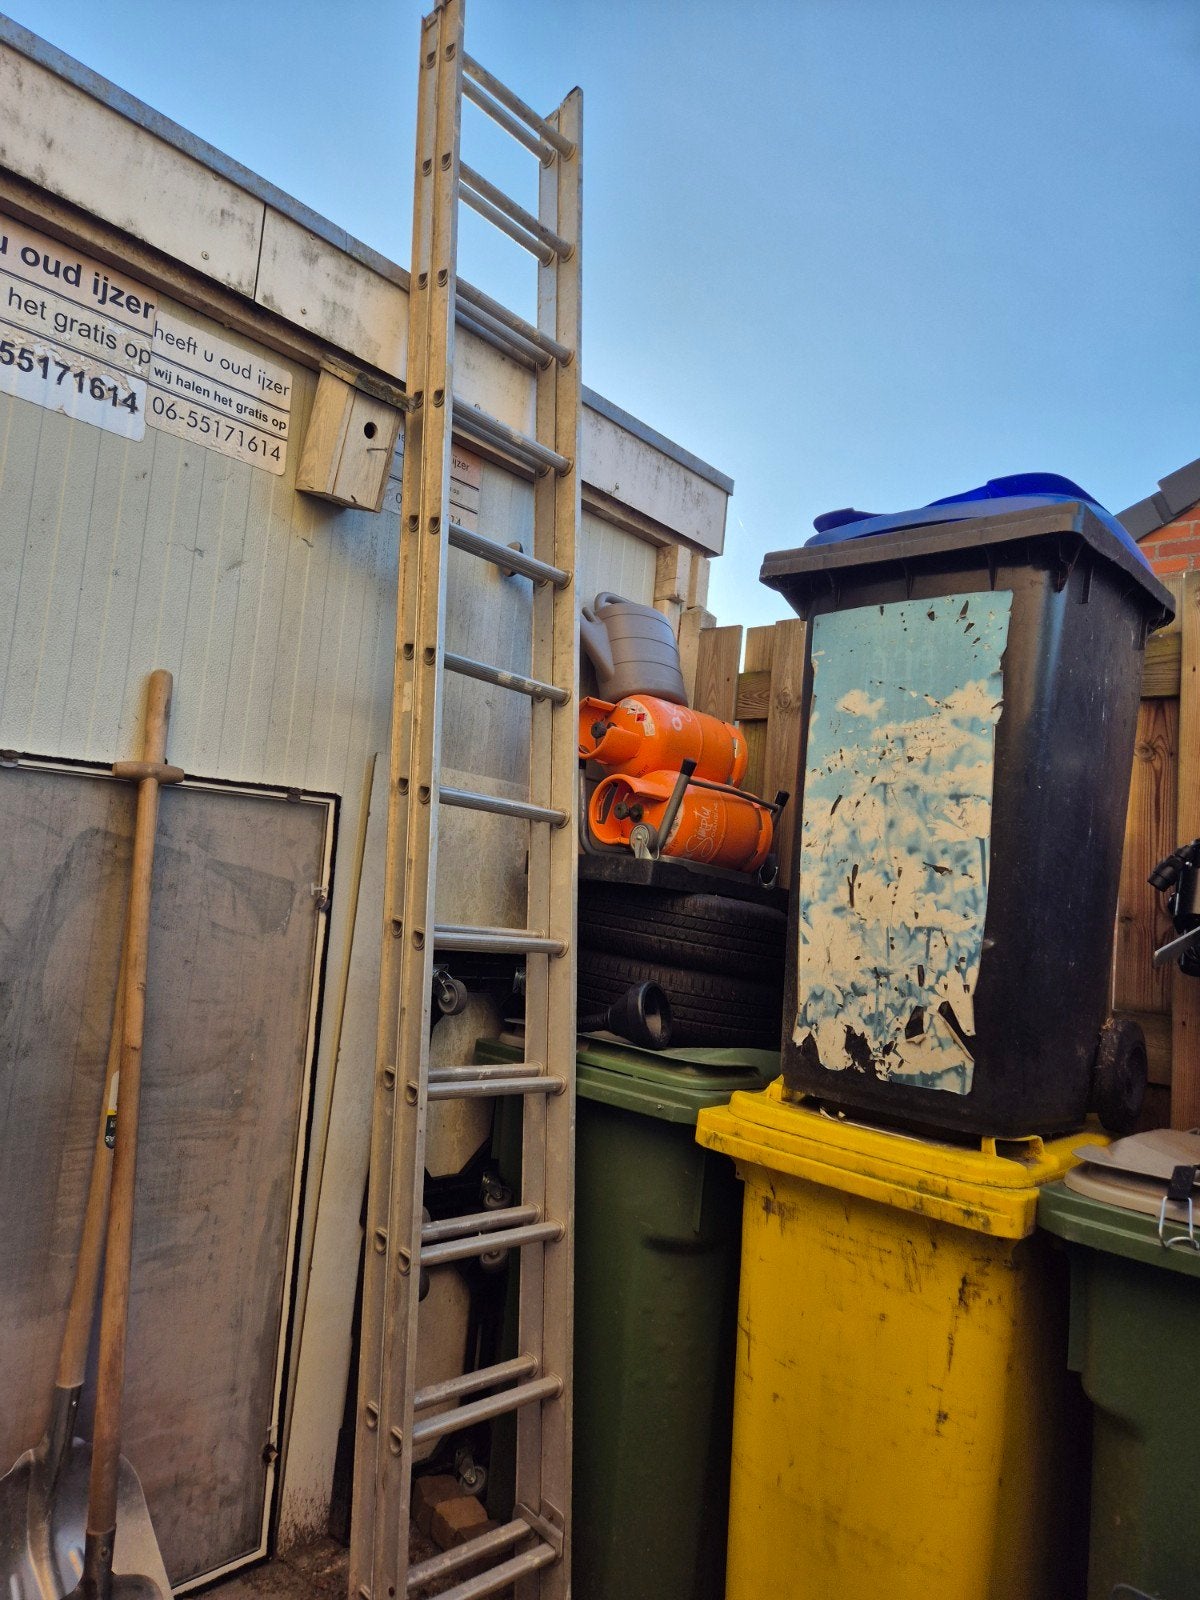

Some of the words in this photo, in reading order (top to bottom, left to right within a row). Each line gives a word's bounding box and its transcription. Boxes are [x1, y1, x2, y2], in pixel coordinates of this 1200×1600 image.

[20, 246, 82, 288] oud
[92, 271, 155, 319] ijzer
[9, 286, 47, 321] het
[54, 312, 117, 350] gratis
[124, 341, 151, 365] op
[154, 320, 198, 356] heeft
[204, 350, 214, 363] u
[219, 358, 252, 380] oud
[257, 369, 291, 396] ijzer
[152, 395, 281, 462] 06-55171614
[154, 366, 172, 384] wij
[175, 374, 211, 399] halen
[213, 390, 234, 408] het
[236, 401, 269, 423] gratis
[271, 418, 287, 431] op
